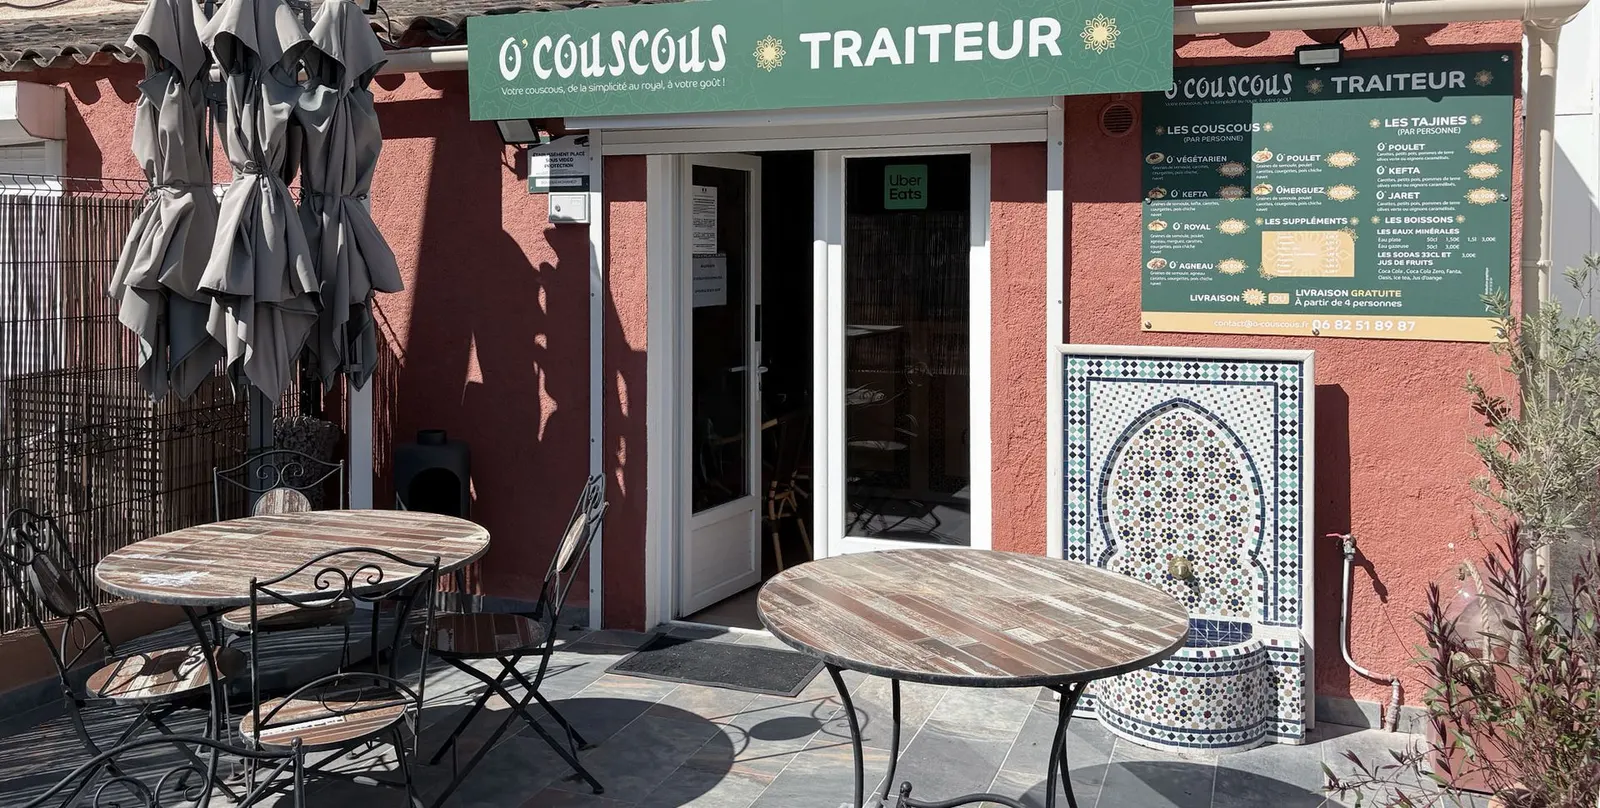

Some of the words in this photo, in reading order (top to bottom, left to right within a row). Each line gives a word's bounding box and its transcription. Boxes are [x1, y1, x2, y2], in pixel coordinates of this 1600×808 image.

[799, 17, 1062, 70] TRAITEUR
[501, 86, 523, 96] Votre
[525, 85, 565, 95] couscous,
[568, 84, 578, 93] de
[579, 83, 587, 92] la
[589, 81, 627, 93] simplicité
[641, 80, 665, 92] royal,
[667, 80, 673, 89] à
[675, 80, 698, 89] votre
[700, 78, 721, 89] goût
[722, 78, 725, 87] !
[1330, 70, 1466, 94] TRAITEUR
[1385, 118, 1408, 127] LES
[1411, 116, 1467, 126] TAJINES
[1167, 126, 1188, 134] LES
[1192, 122, 1260, 134] COUSCOUS
[1417, 127, 1461, 135] PERSONNE)
[1176, 155, 1227, 163] VÉGÉTARIEN
[890, 175, 922, 186] Uber
[890, 188, 921, 200] Eats
[1282, 216, 1348, 225] SUPPLÉMENTS
[1295, 289, 1348, 297] LIVRAISON
[1351, 289, 1402, 297] GRATUITE
[1304, 299, 1329, 307] partir
[1312, 320, 1330, 330] 06
[1334, 320, 1351, 330] 82
[1356, 320, 1370, 330] 51
[1375, 320, 1393, 330] 89
[1397, 321, 1416, 331] 87
